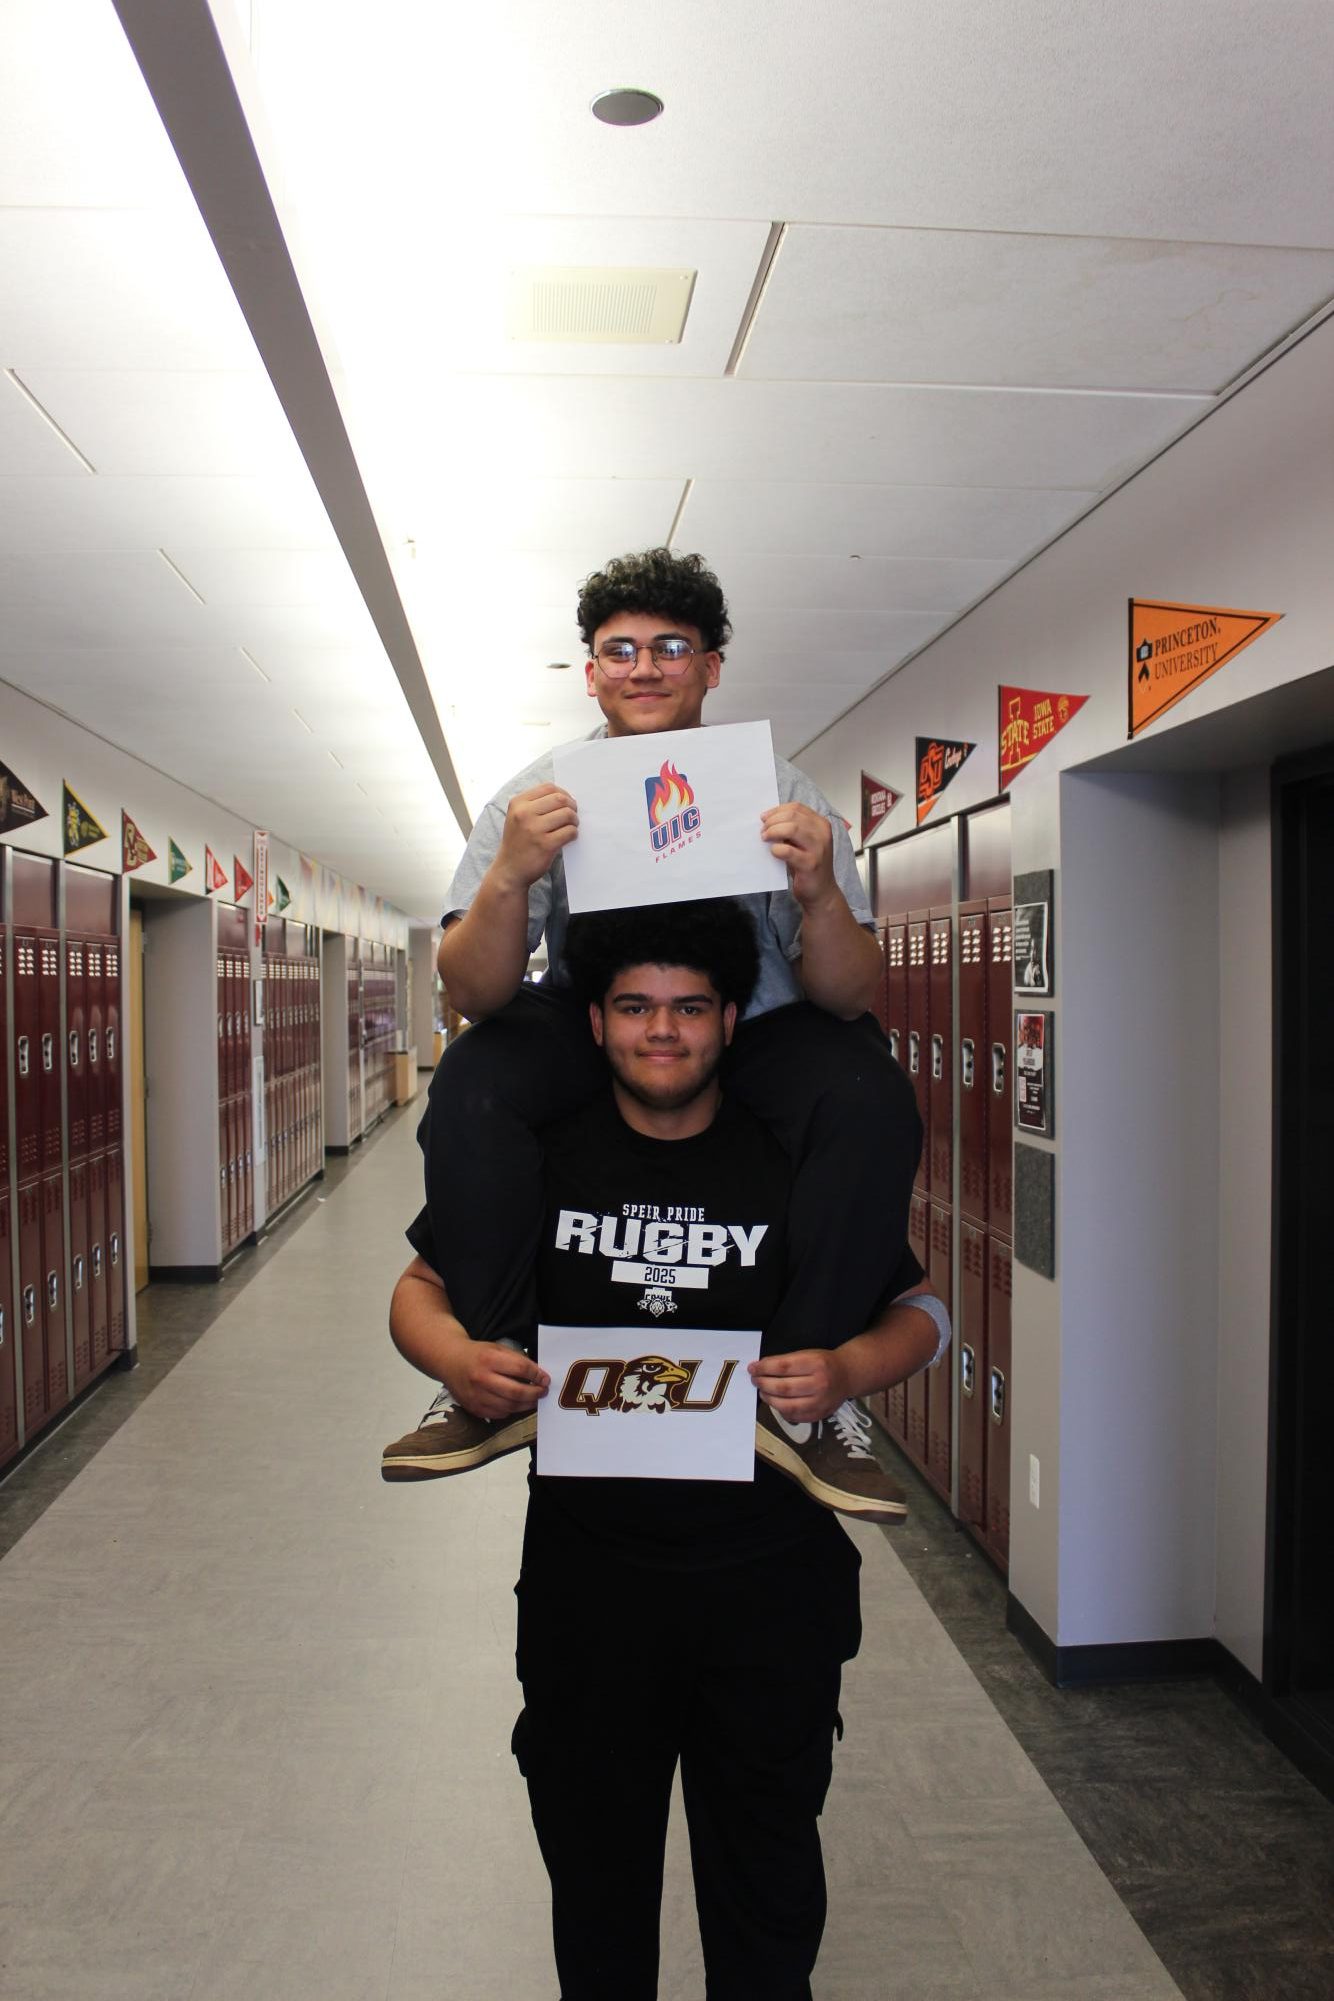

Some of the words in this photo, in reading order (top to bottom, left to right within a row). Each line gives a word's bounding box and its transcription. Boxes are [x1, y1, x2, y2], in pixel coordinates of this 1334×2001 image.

[1155, 617, 1218, 657] PRINCETON
[1154, 642, 1219, 680] UNIVERSITY
[1033, 698, 1053, 721] IOWA
[1000, 719, 1030, 757] STATE
[1033, 715, 1055, 740] STATE
[650, 805, 701, 852] UIC
[655, 831, 702, 863] FLAMES
[666, 1206, 706, 1222] PRIDE
[555, 1209, 769, 1267] RUGBY
[644, 1266, 677, 1285] 2025
